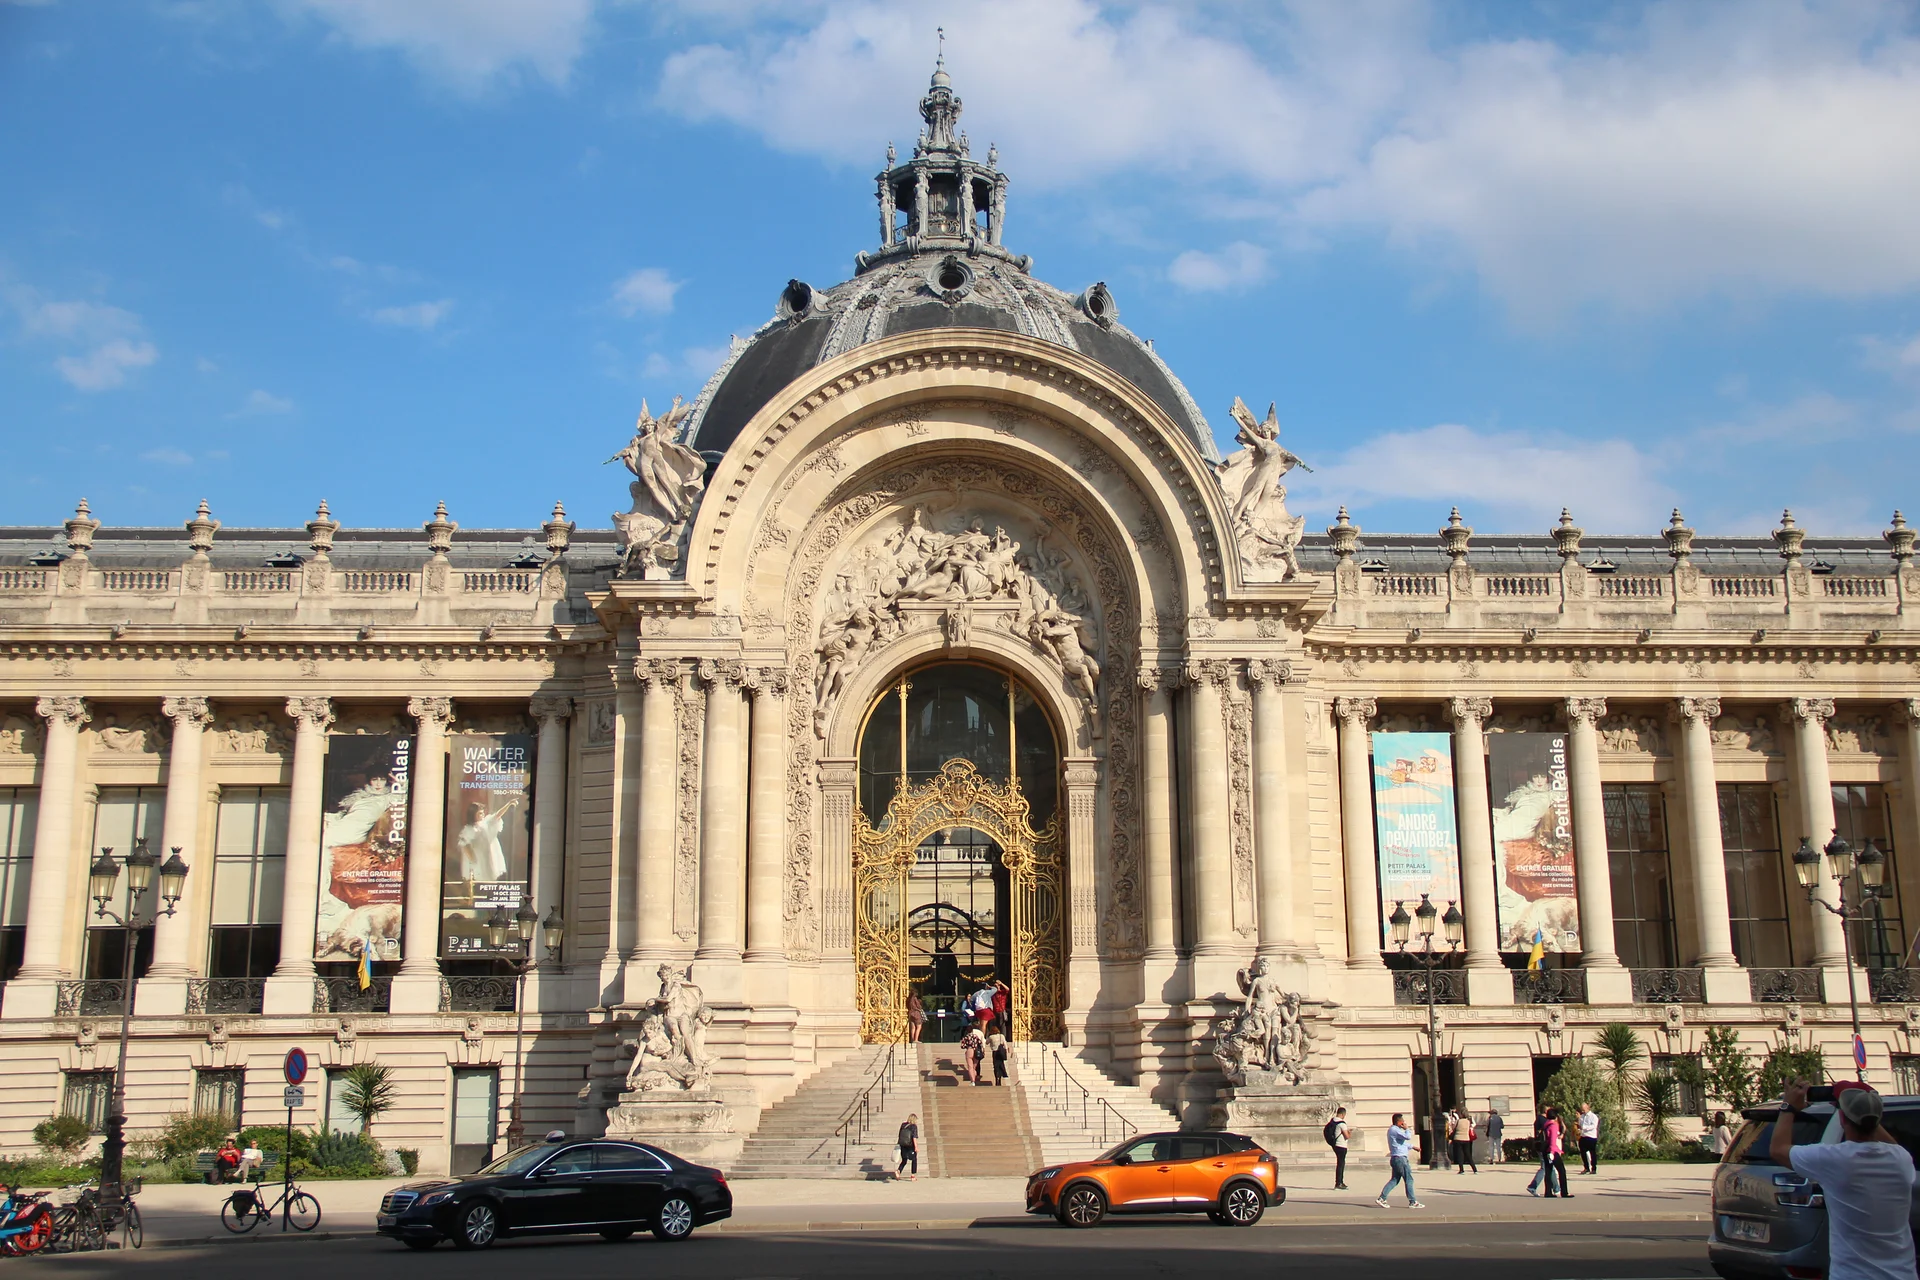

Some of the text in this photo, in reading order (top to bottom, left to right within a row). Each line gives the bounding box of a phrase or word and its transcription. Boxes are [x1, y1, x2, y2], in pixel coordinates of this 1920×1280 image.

[463, 747, 525, 760] WALTER
[463, 761, 528, 774] SICKERT
[389, 739, 410, 843] Petit Palais
[1549, 738, 1570, 839] Petit Palais
[342, 869, 368, 877] ENTRÉE
